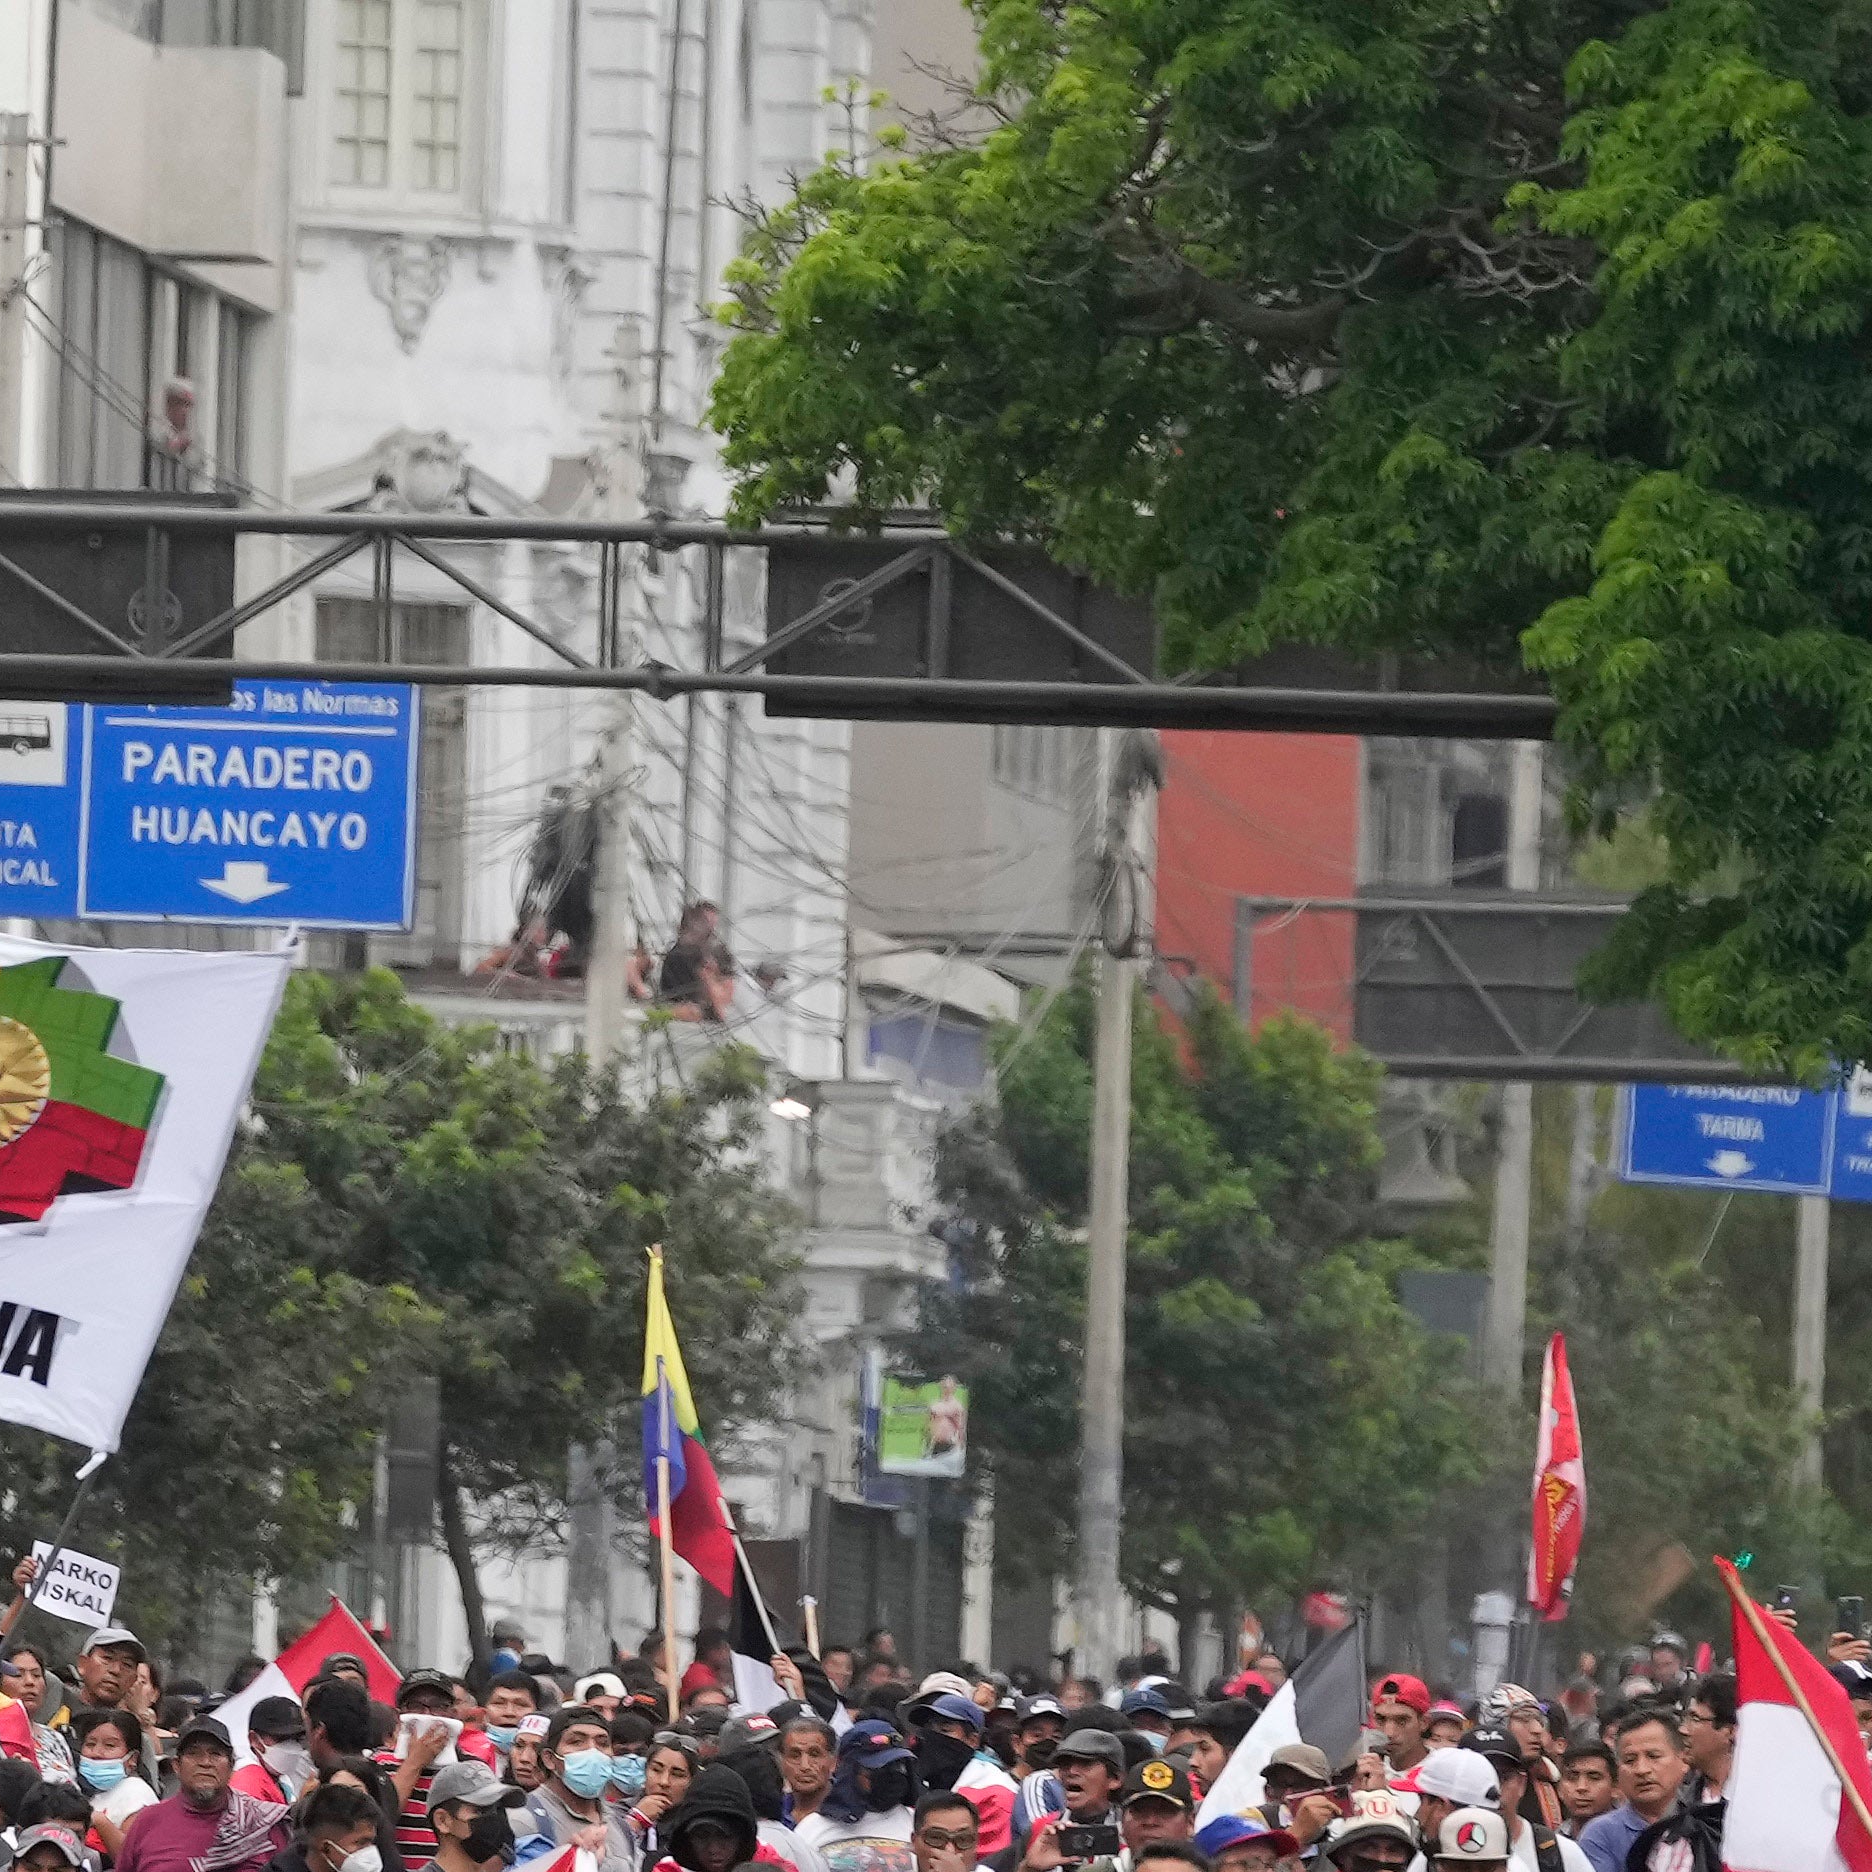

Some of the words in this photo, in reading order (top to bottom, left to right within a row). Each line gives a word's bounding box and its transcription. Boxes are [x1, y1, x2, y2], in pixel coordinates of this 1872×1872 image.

[264, 687, 298, 713] las
[302, 687, 399, 717] Normas
[122, 741, 373, 793] PARADERO
[131, 805, 367, 850] HUANCAYO
[34, 1579, 106, 1616] ISKAL
